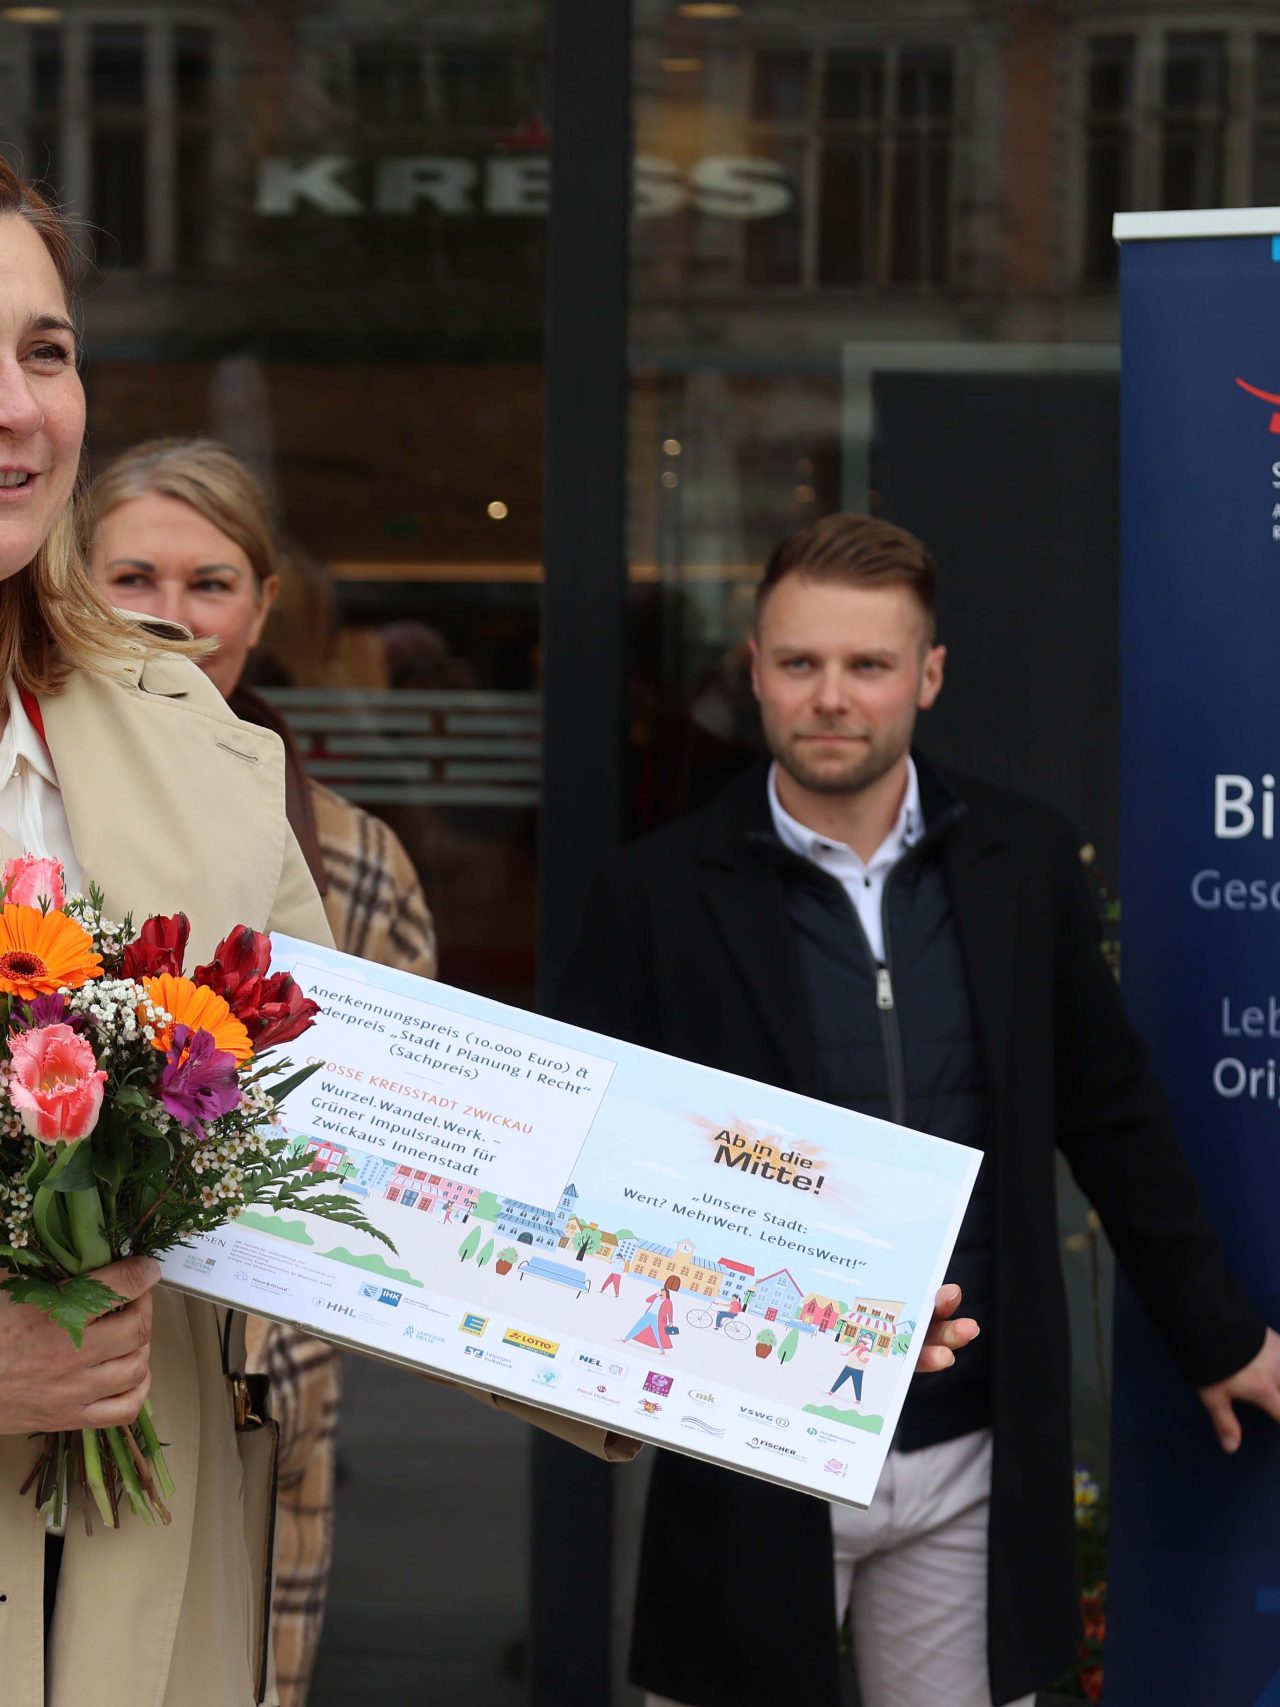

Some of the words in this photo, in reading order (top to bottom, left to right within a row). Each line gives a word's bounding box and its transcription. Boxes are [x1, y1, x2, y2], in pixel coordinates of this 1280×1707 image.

[254, 153, 795, 221] KRESS
[308, 984, 461, 1039] Anerkennungspreis
[465, 1031, 523, 1059] (10.000
[528, 1050, 571, 1074] Euro)
[575, 1067, 589, 1079] &
[321, 1005, 386, 1034] derpreis
[456, 1047, 521, 1077] Planung
[389, 1044, 479, 1080] (Sachpreis)
[320, 1081, 486, 1143] Wurzel.Wandel.Werk.
[369, 1074, 459, 1111] KREISSTADT
[463, 1105, 535, 1136] ZWICKAU
[311, 1096, 366, 1121] Grüner
[370, 1115, 466, 1155] Impulsraum
[472, 1146, 497, 1164] für
[311, 1115, 386, 1148] Zwickaus
[391, 1141, 480, 1177] Innenstadt
[714, 1130, 746, 1149] Ab
[752, 1140, 773, 1157] in
[779, 1149, 814, 1170] die
[713, 1144, 826, 1195] Mitte!
[623, 1187, 668, 1209] Wert?
[671, 1203, 753, 1238] MehrWert.
[762, 1212, 809, 1235] Stadt:
[326, 1301, 357, 1318] HHL
[383, 1290, 401, 1301] IHK
[522, 1336, 552, 1349] LOTTO
[578, 1354, 603, 1368] NEL
[739, 1406, 774, 1423] VSWG
[760, 1440, 797, 1456] FISCHER
